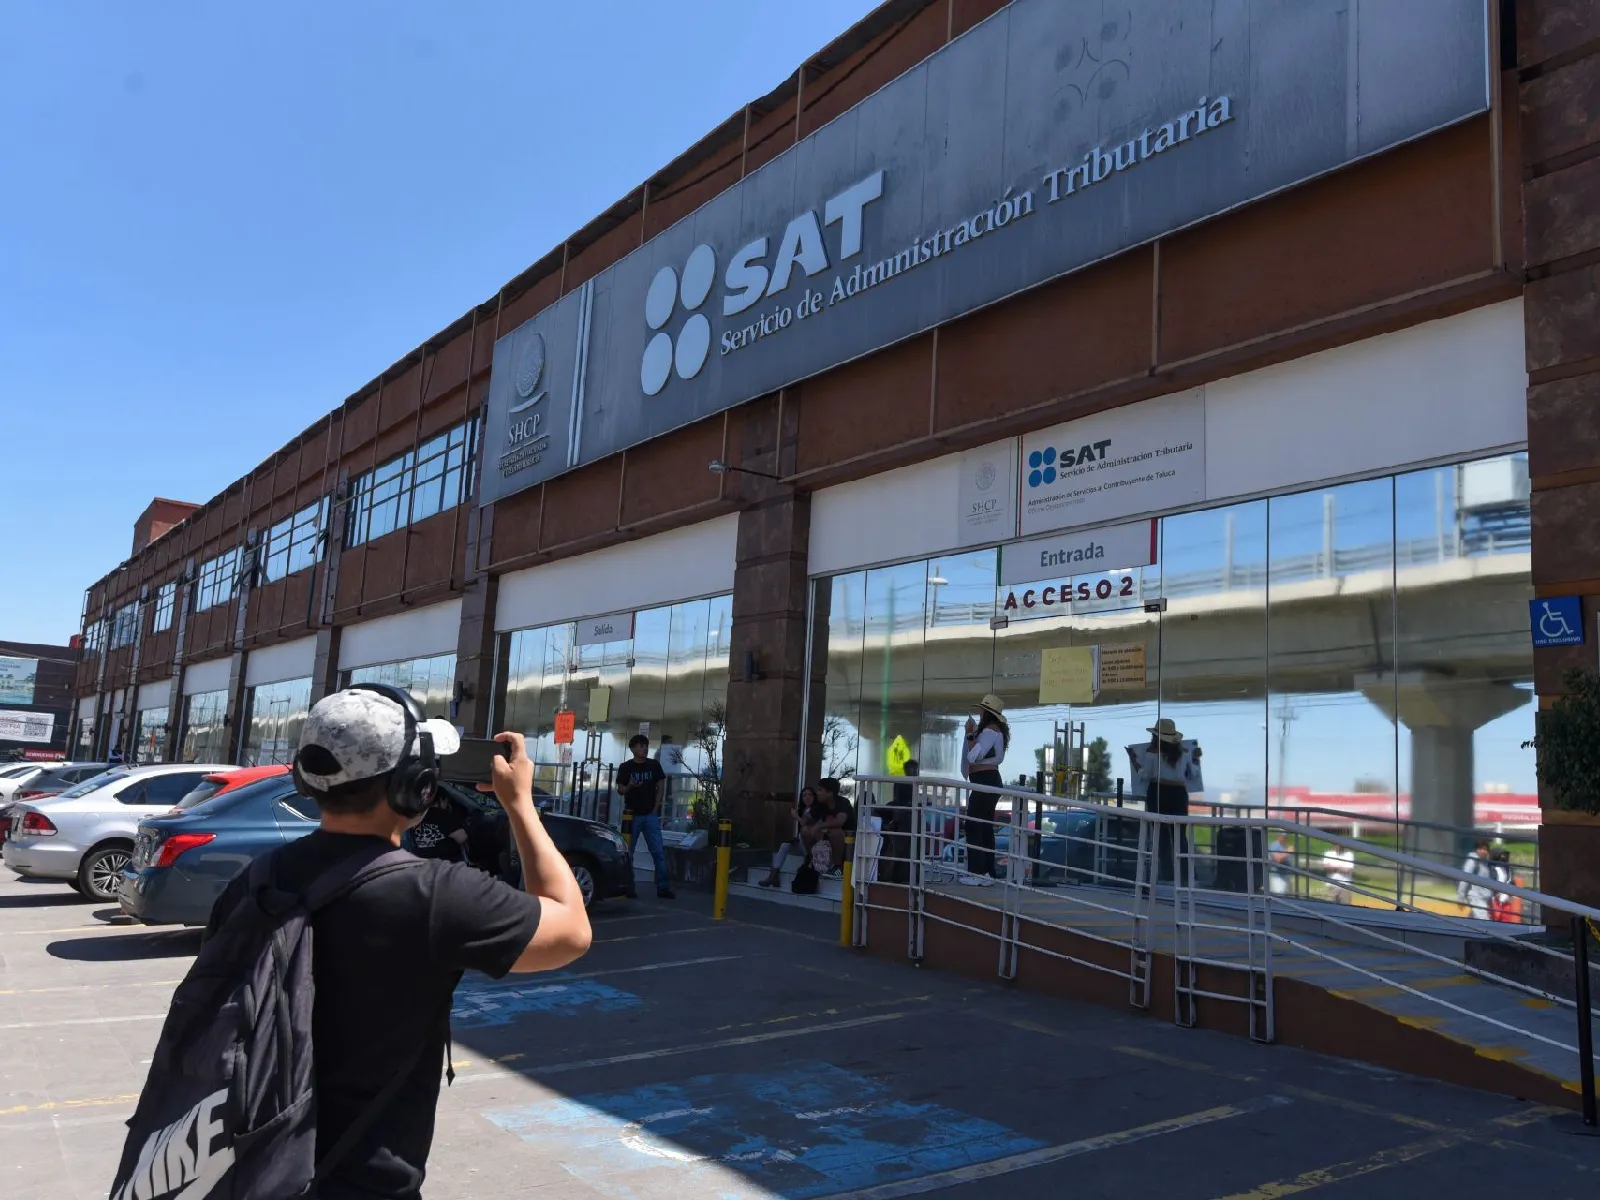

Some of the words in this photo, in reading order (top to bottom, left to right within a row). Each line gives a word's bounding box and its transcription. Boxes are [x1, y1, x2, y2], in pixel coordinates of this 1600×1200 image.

[720, 305, 792, 356] Servicio
[797, 289, 823, 320] de
[829, 187, 1036, 306] Administración
[1043, 95, 1235, 204] Tributaria
[723, 170, 886, 316] SAT
[508, 413, 540, 447] SHCP
[1059, 439, 1112, 469] SAT
[1060, 466, 1085, 480] Servicio
[1086, 465, 1095, 474] de
[1155, 441, 1193, 457] Tributaria
[1155, 469, 1176, 480] Toluca
[1040, 542, 1105, 568] Entrada
[1004, 579, 1112, 610] ACCESO
[1119, 576, 1133, 596] 2
